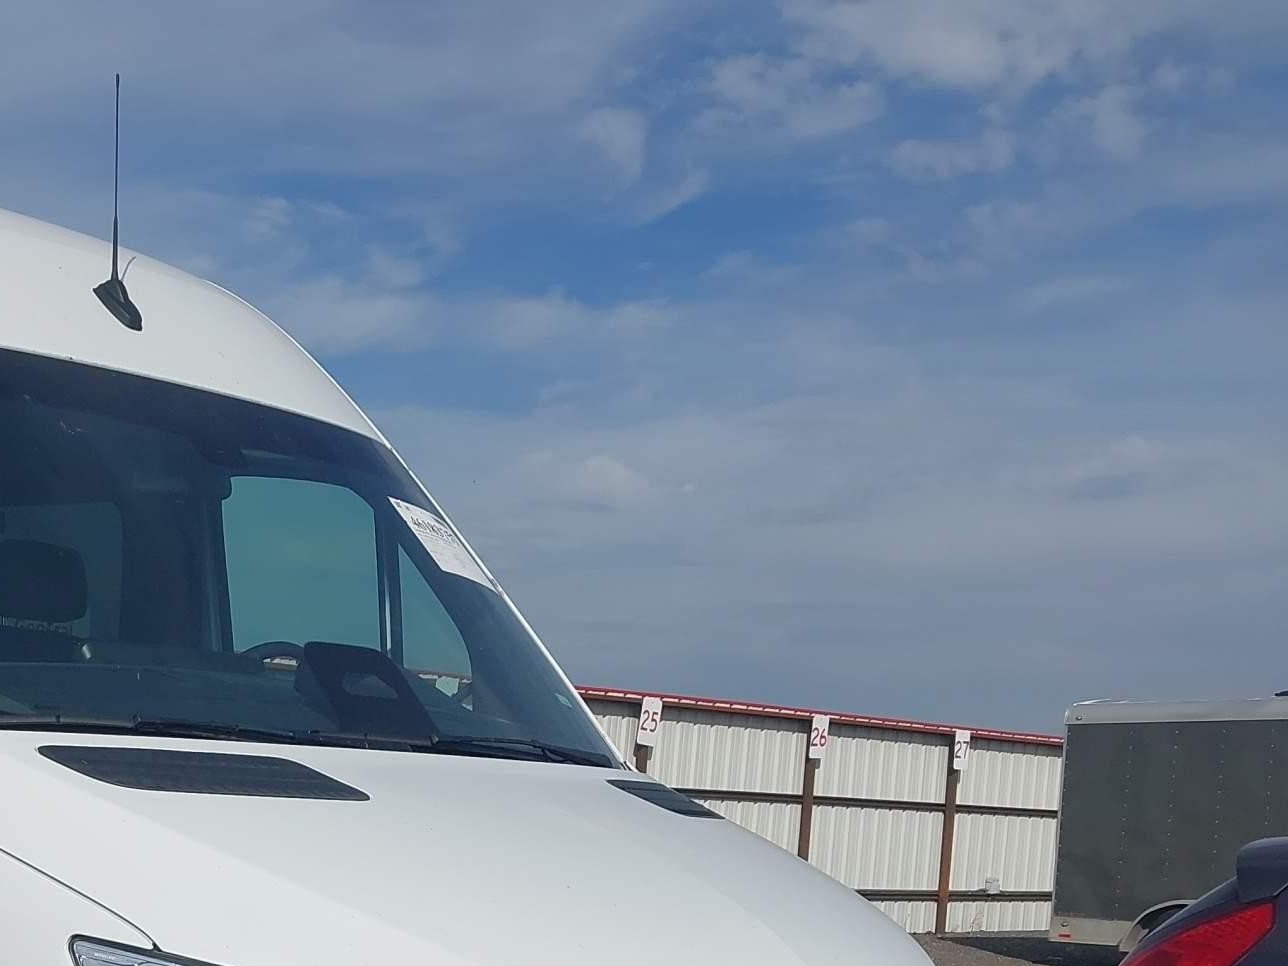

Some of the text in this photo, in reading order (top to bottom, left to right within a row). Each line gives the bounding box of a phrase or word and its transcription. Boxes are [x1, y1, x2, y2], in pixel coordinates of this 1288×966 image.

[640, 709, 659, 733] 25
[810, 726, 827, 747] 26
[954, 740, 970, 759] 27
